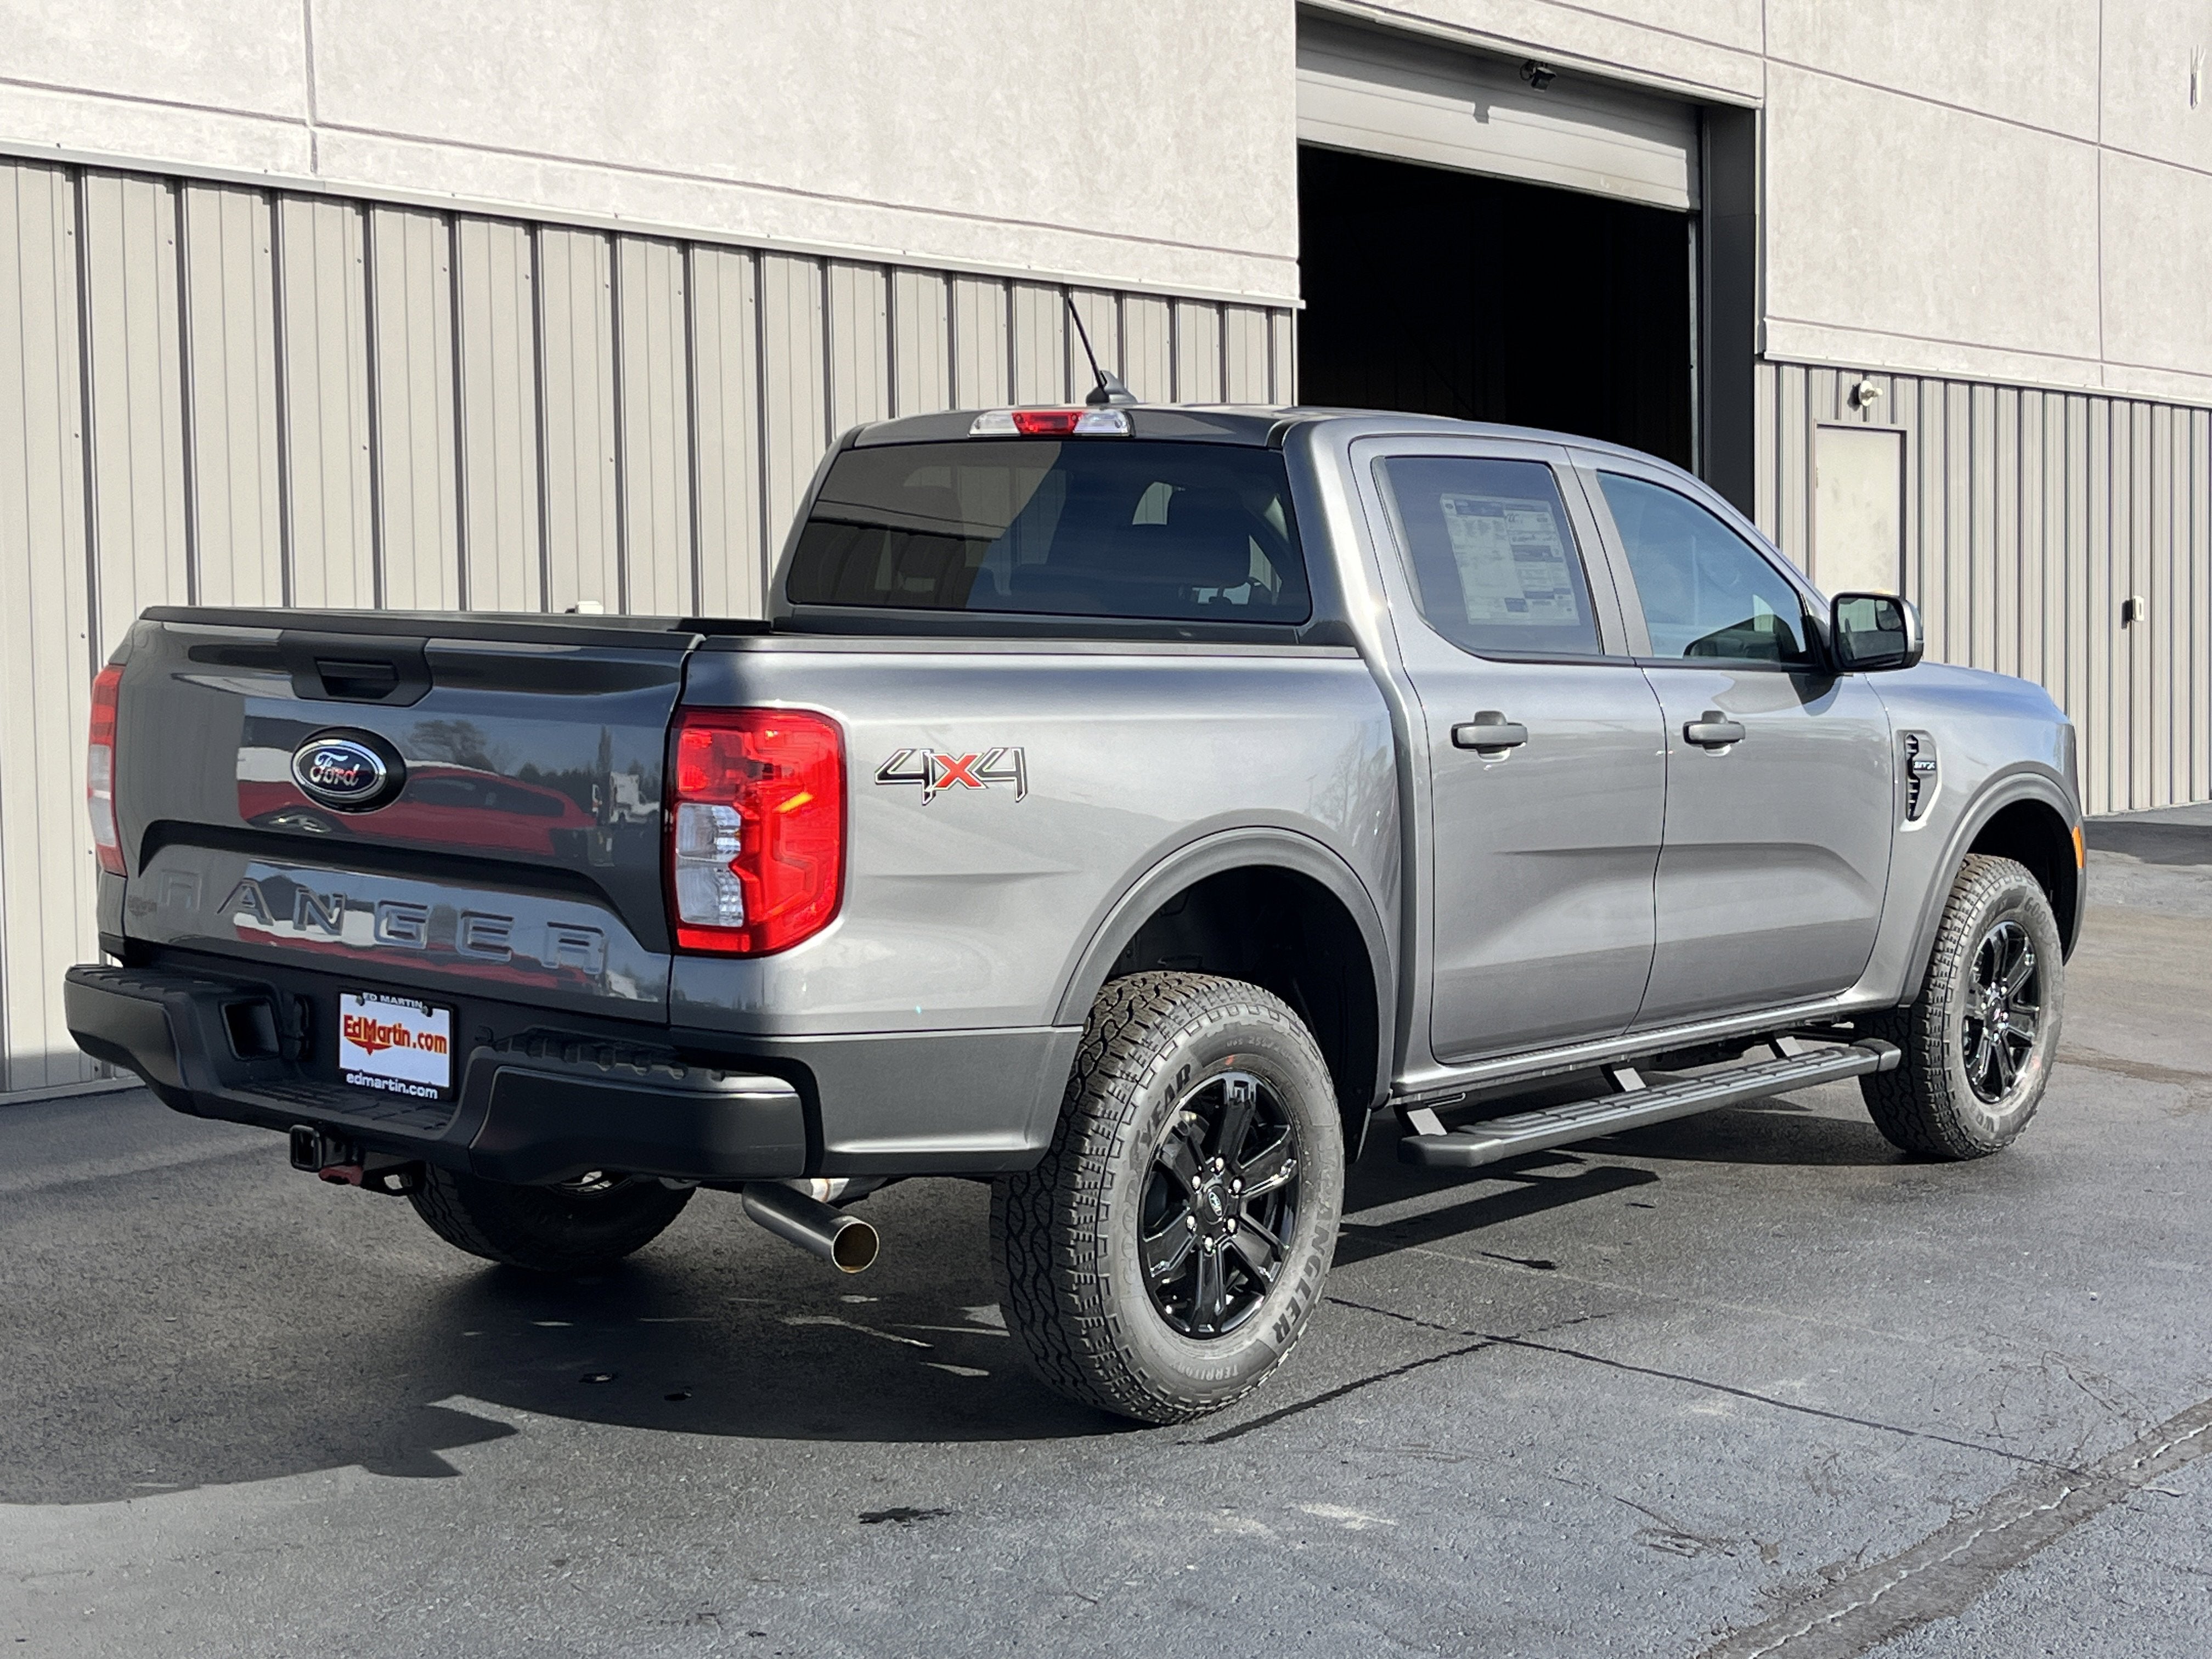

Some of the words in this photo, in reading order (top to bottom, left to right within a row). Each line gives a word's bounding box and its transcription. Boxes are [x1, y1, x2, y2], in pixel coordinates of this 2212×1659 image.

[309, 751, 360, 787] Ford
[157, 868, 611, 975] RANGER
[362, 992, 377, 1002] ED
[380, 995, 423, 1009] MARTIN
[346, 1072, 438, 1099] edmartin.com
